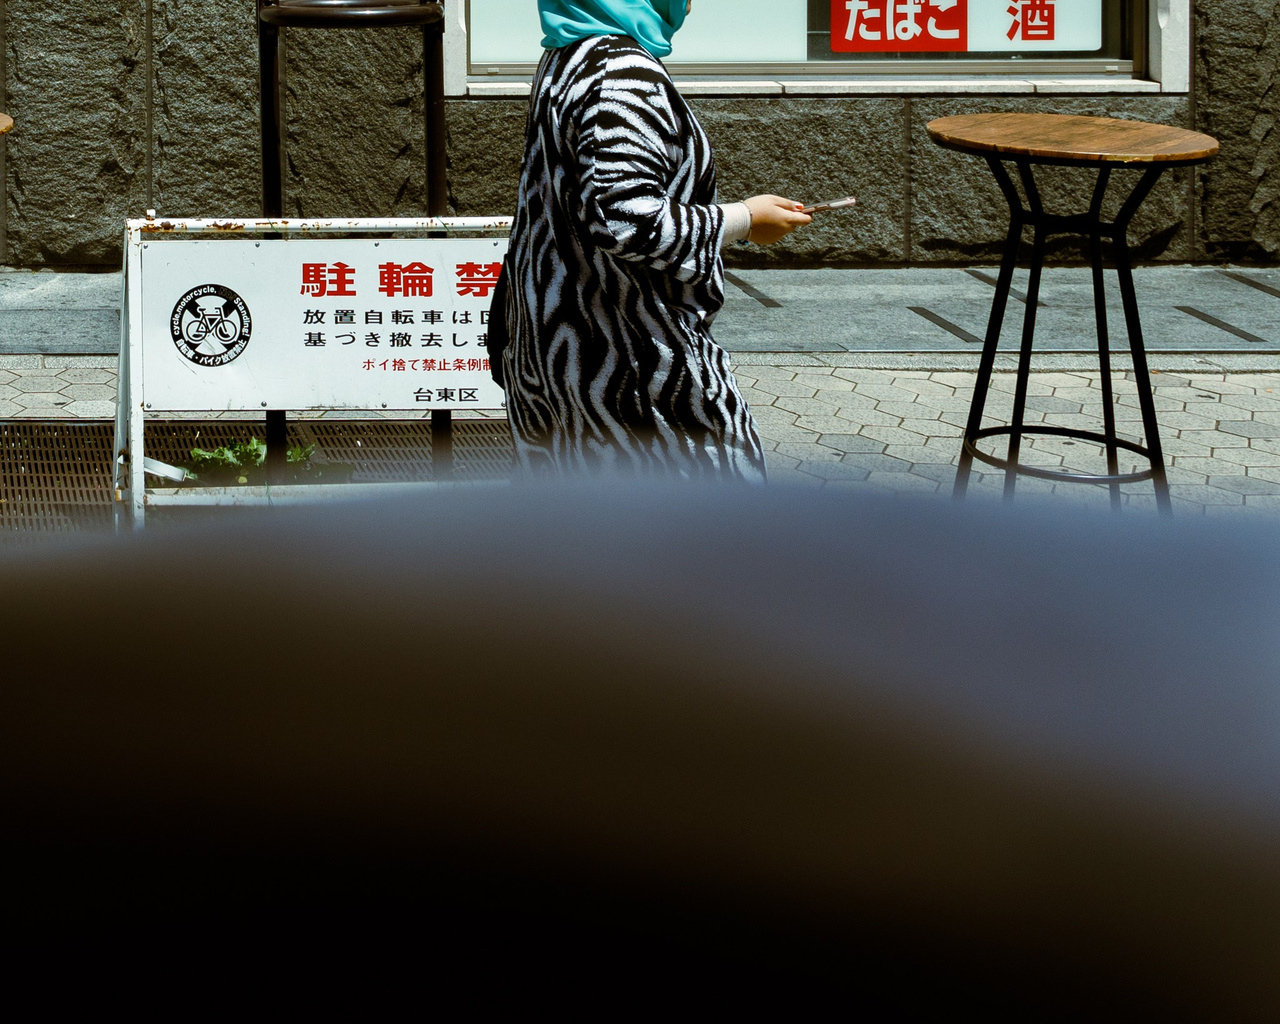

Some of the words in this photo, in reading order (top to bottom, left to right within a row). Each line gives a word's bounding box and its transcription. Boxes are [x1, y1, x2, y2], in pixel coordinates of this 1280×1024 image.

[300, 261, 503, 298] 駐輪禁
[413, 388, 479, 403] 台東区
